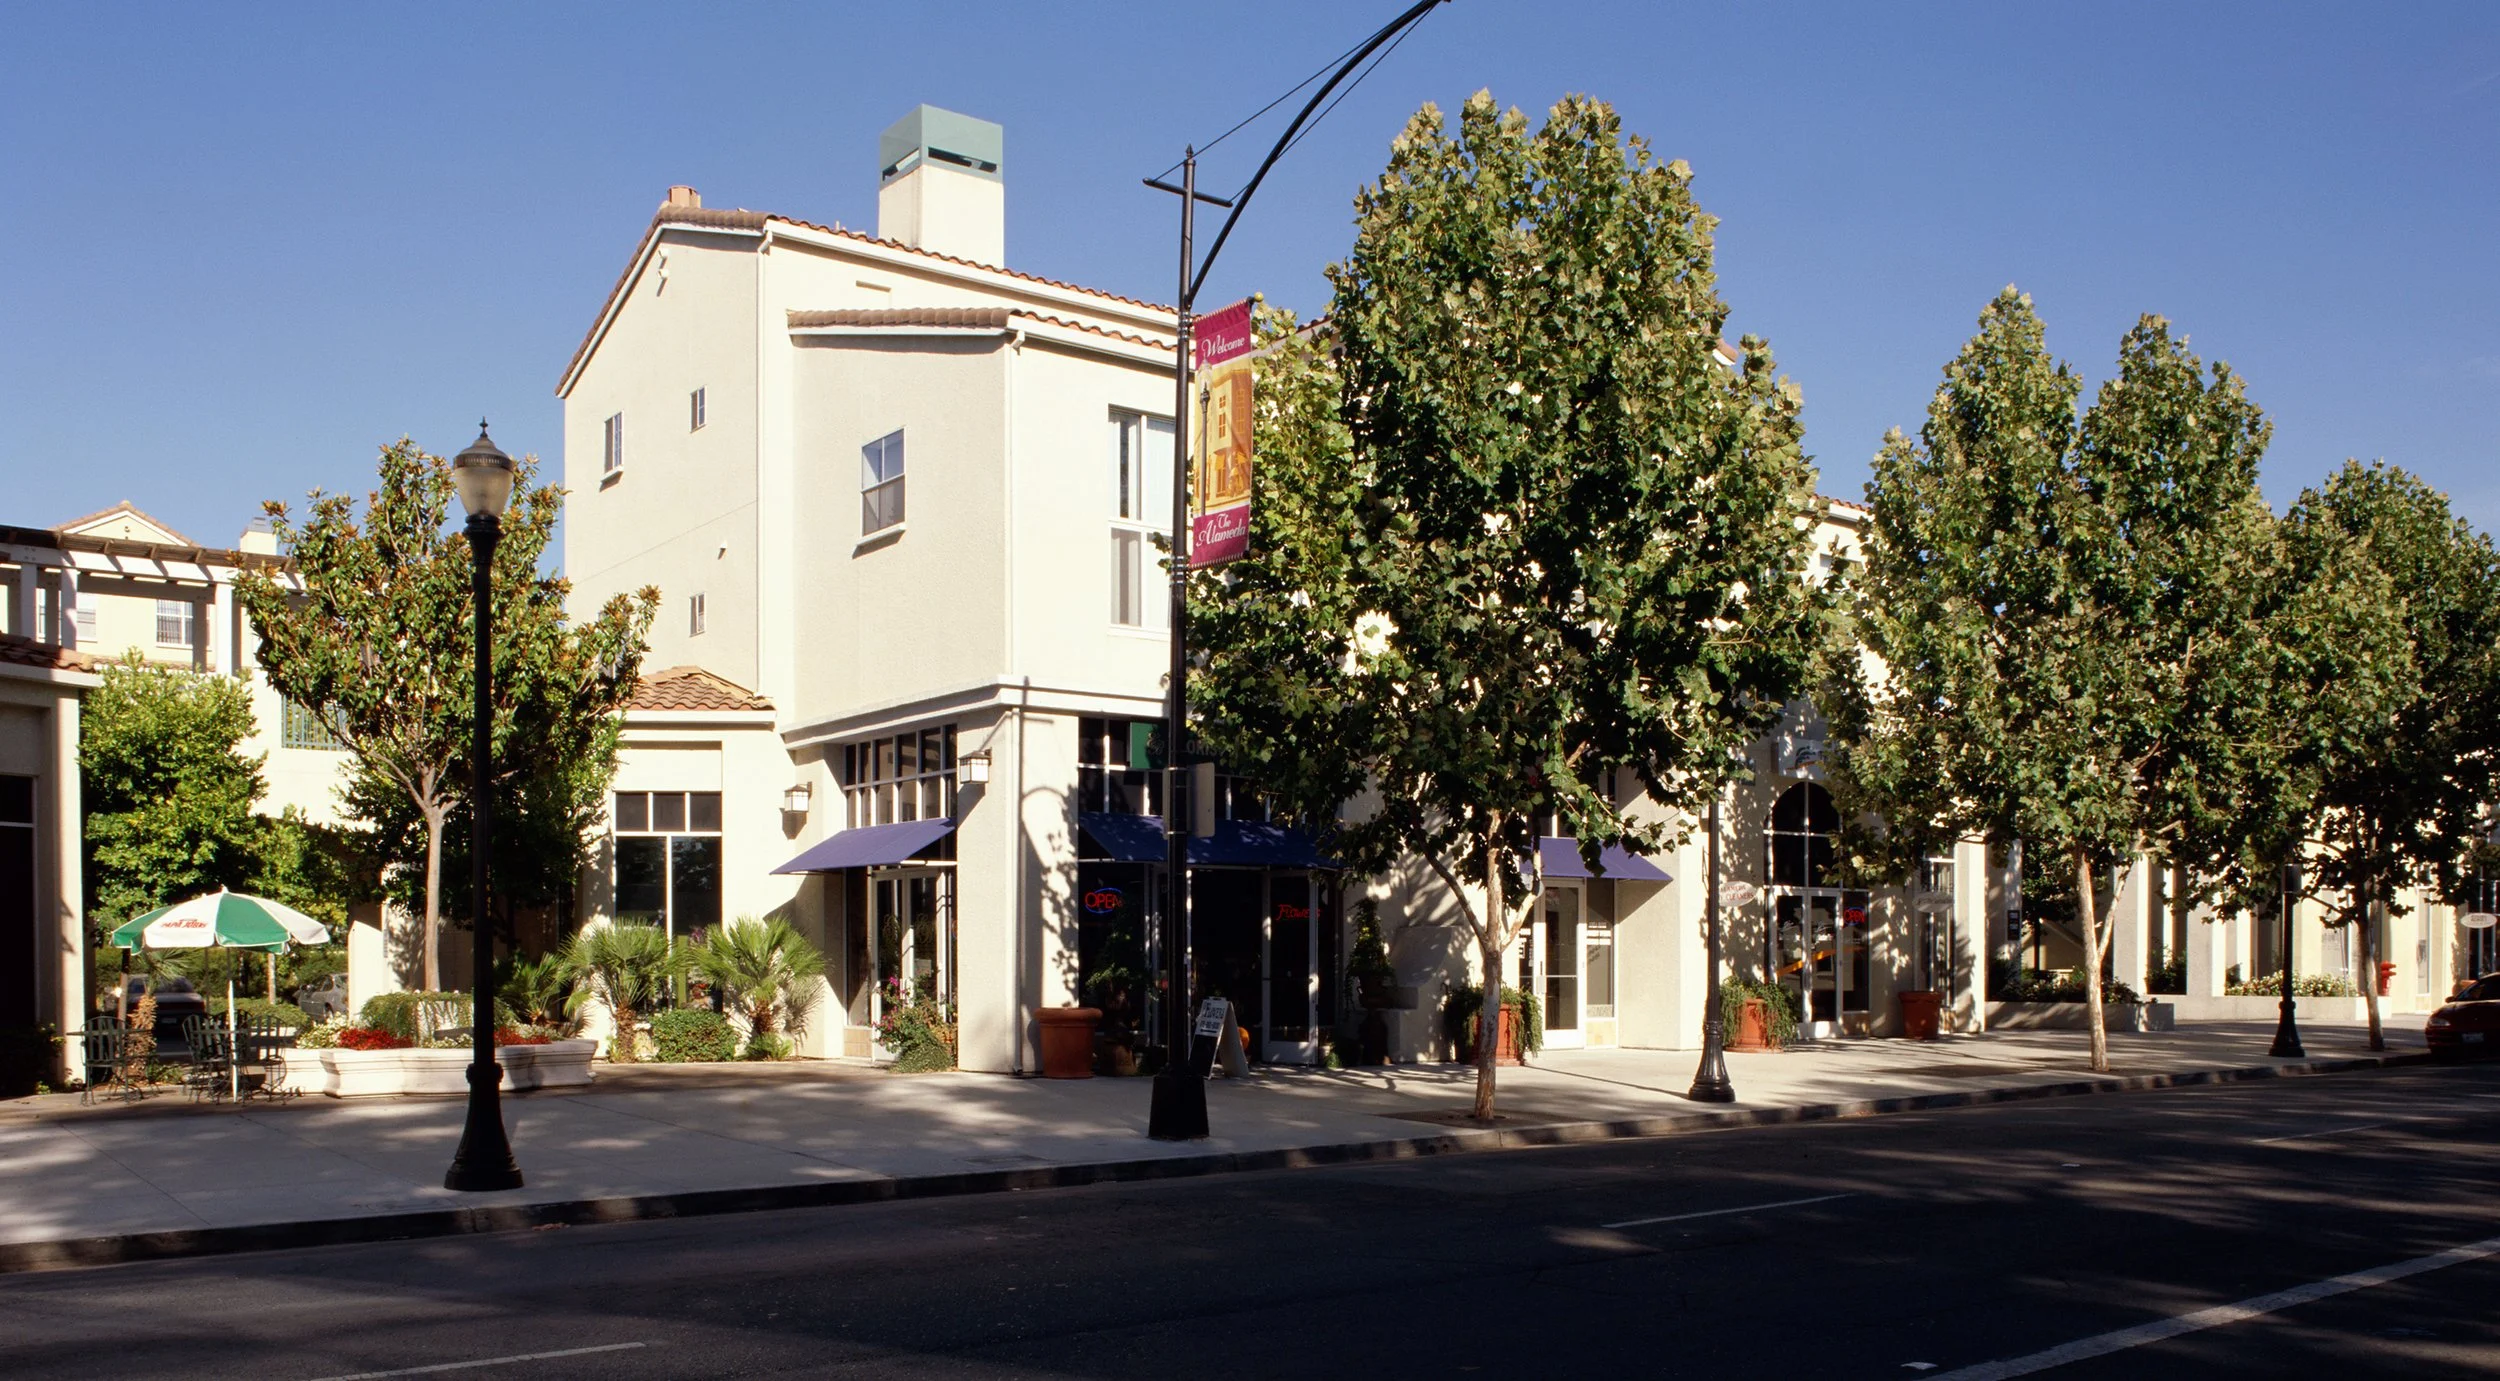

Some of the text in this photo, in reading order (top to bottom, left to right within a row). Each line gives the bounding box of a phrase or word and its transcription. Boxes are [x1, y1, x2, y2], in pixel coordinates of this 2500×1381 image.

[1201, 334, 1245, 358] Welcome
[1216, 512, 1232, 529] The
[1195, 519, 1247, 547] Alameda
[1085, 892, 1125, 909] OPEN
[1844, 909, 1865, 923] OPEN
